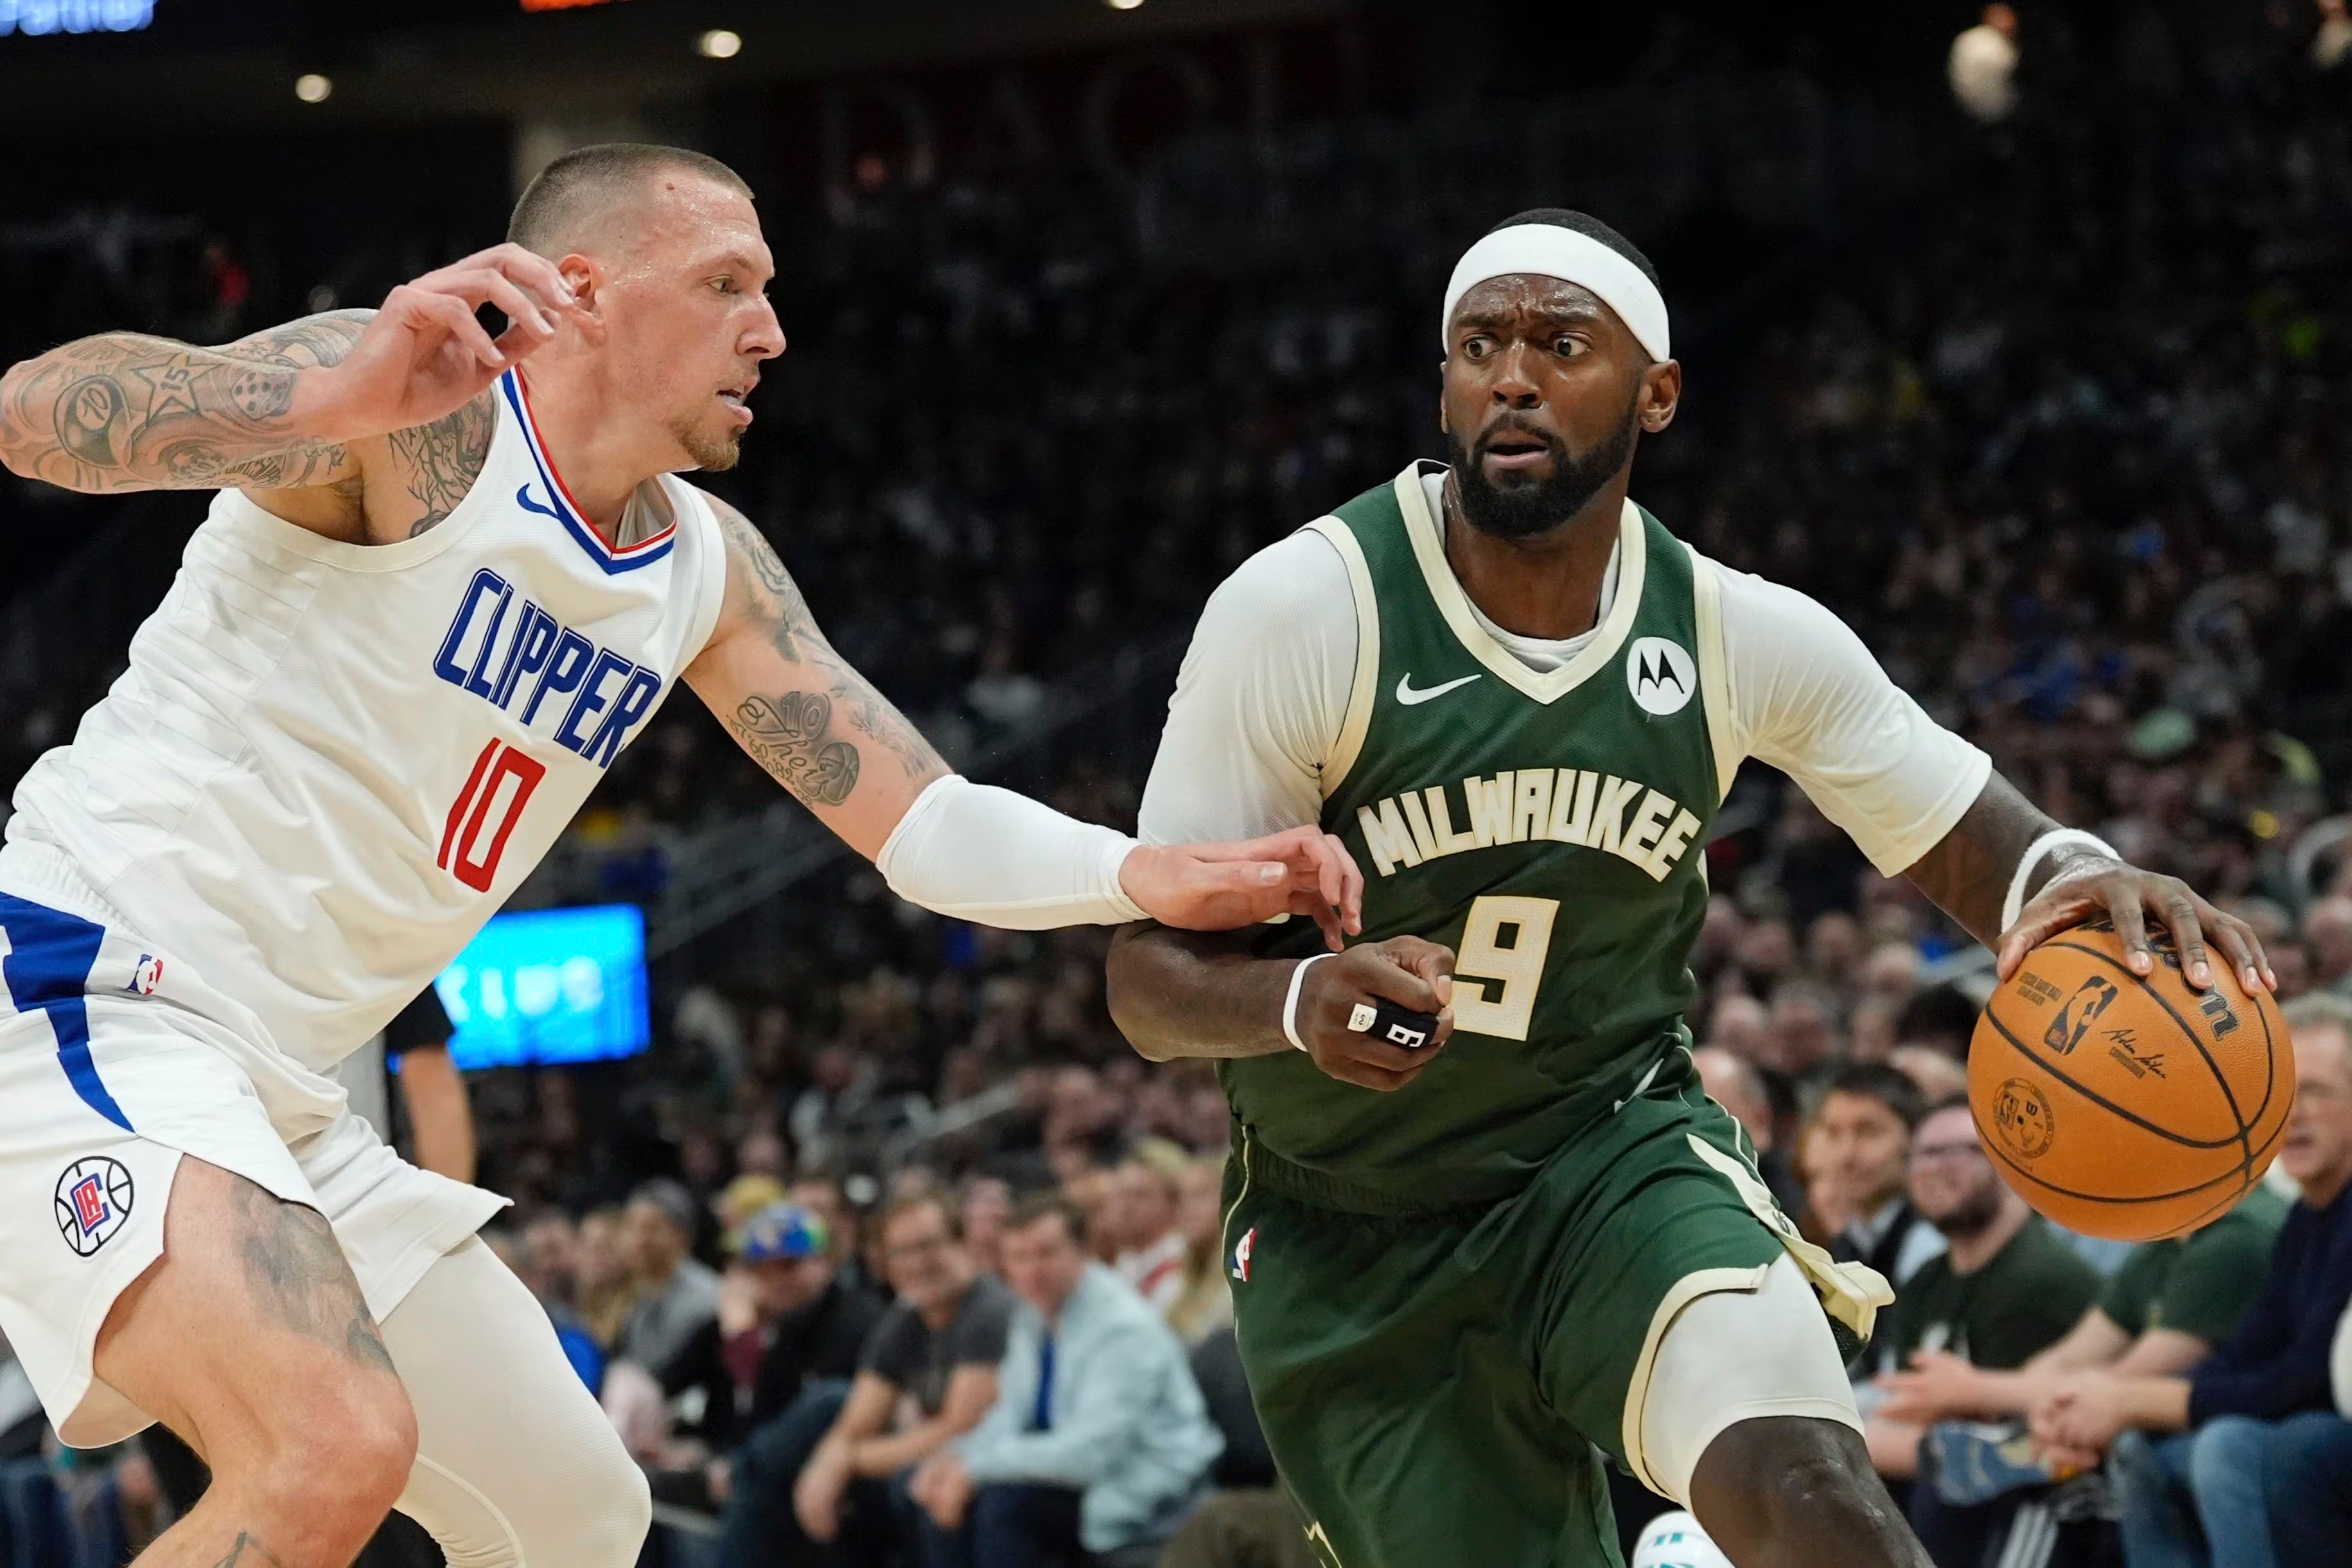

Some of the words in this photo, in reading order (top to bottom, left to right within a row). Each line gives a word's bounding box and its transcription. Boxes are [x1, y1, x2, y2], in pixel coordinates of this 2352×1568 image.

[433, 568, 662, 769] CLIPPER
[437, 737, 546, 892] 10
[1356, 768, 1701, 882] MILWAUKEE
[1452, 896, 1560, 1041] 9
